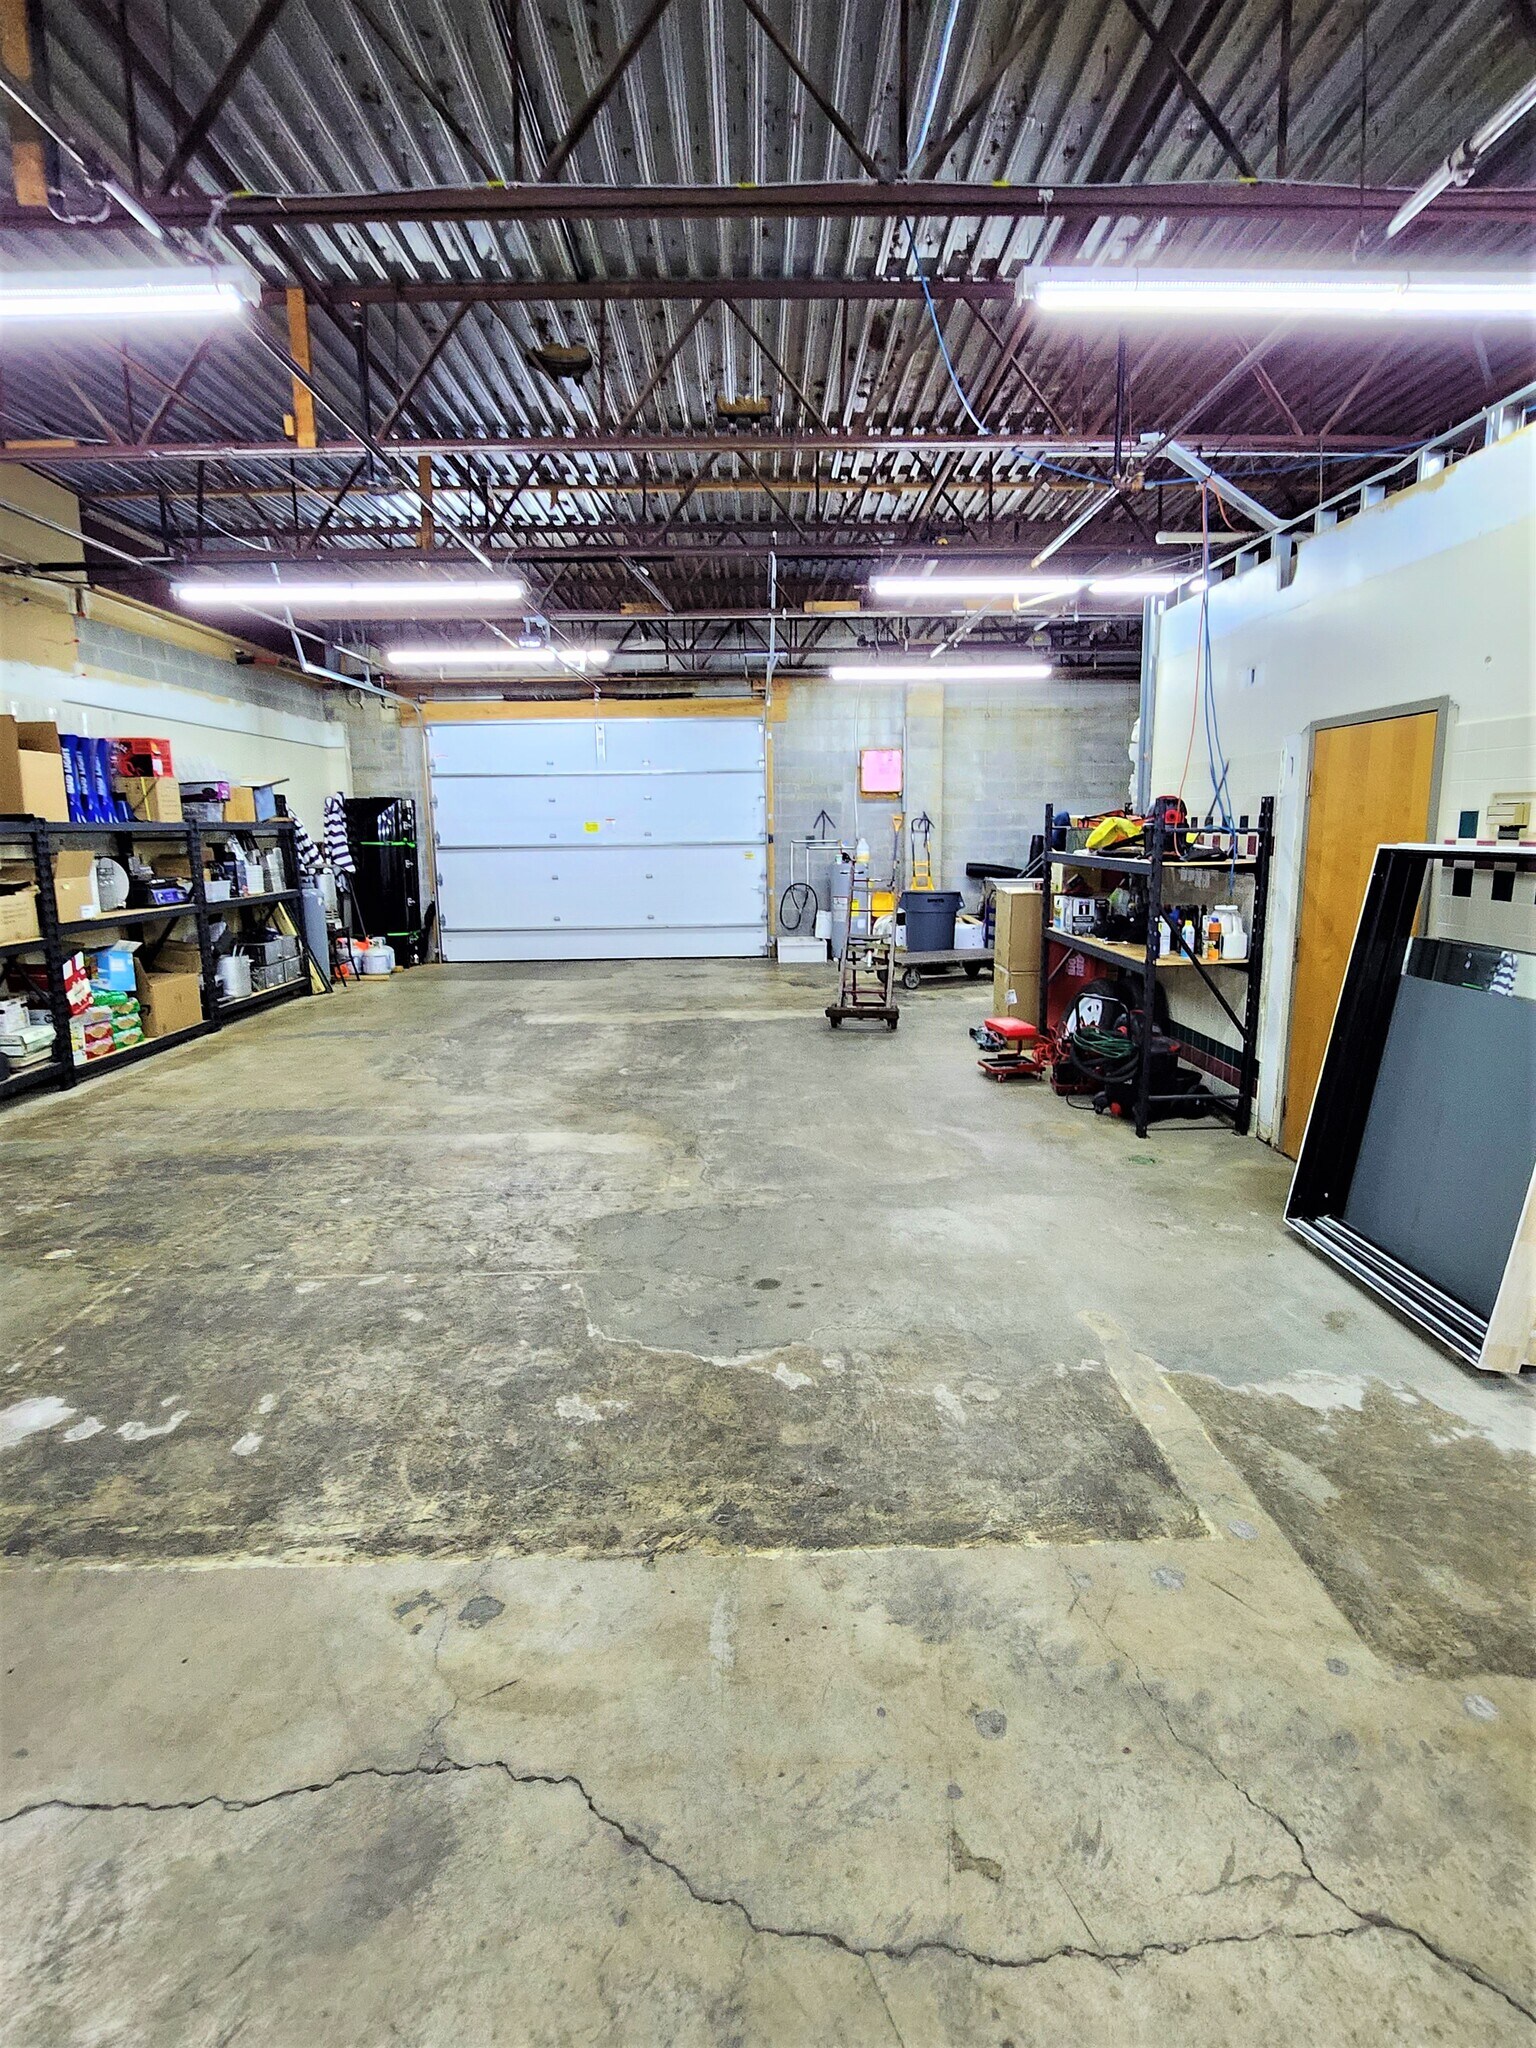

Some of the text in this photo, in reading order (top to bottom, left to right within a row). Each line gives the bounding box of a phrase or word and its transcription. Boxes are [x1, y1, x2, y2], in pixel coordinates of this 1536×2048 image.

[61, 747, 75, 794] BUD LIGHT
[75, 751, 88, 795] BUD LIGHT
